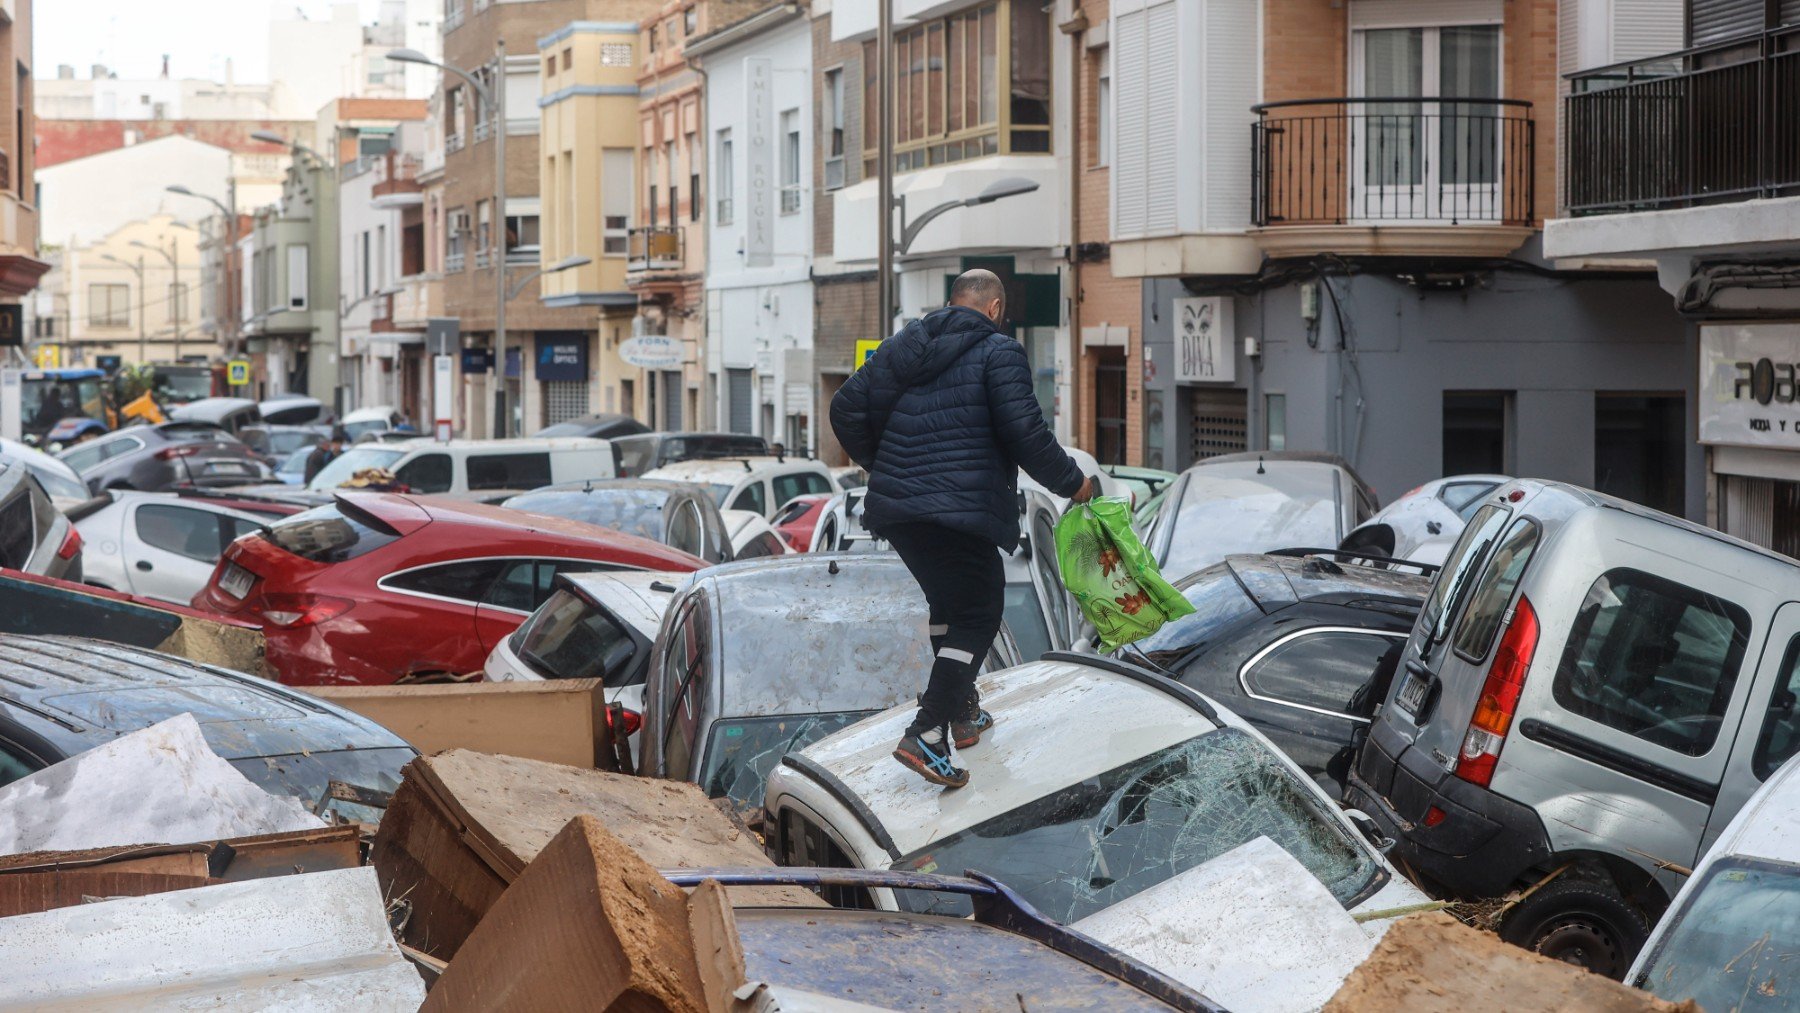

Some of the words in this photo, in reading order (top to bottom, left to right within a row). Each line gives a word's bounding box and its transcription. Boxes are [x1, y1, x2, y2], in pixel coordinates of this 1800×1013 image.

[753, 65, 764, 148] EMILIO
[638, 337, 670, 346] FORN
[1182, 335, 1215, 377] DIVA
[1750, 418, 1771, 432] MODA
[1779, 420, 1786, 432] Y
